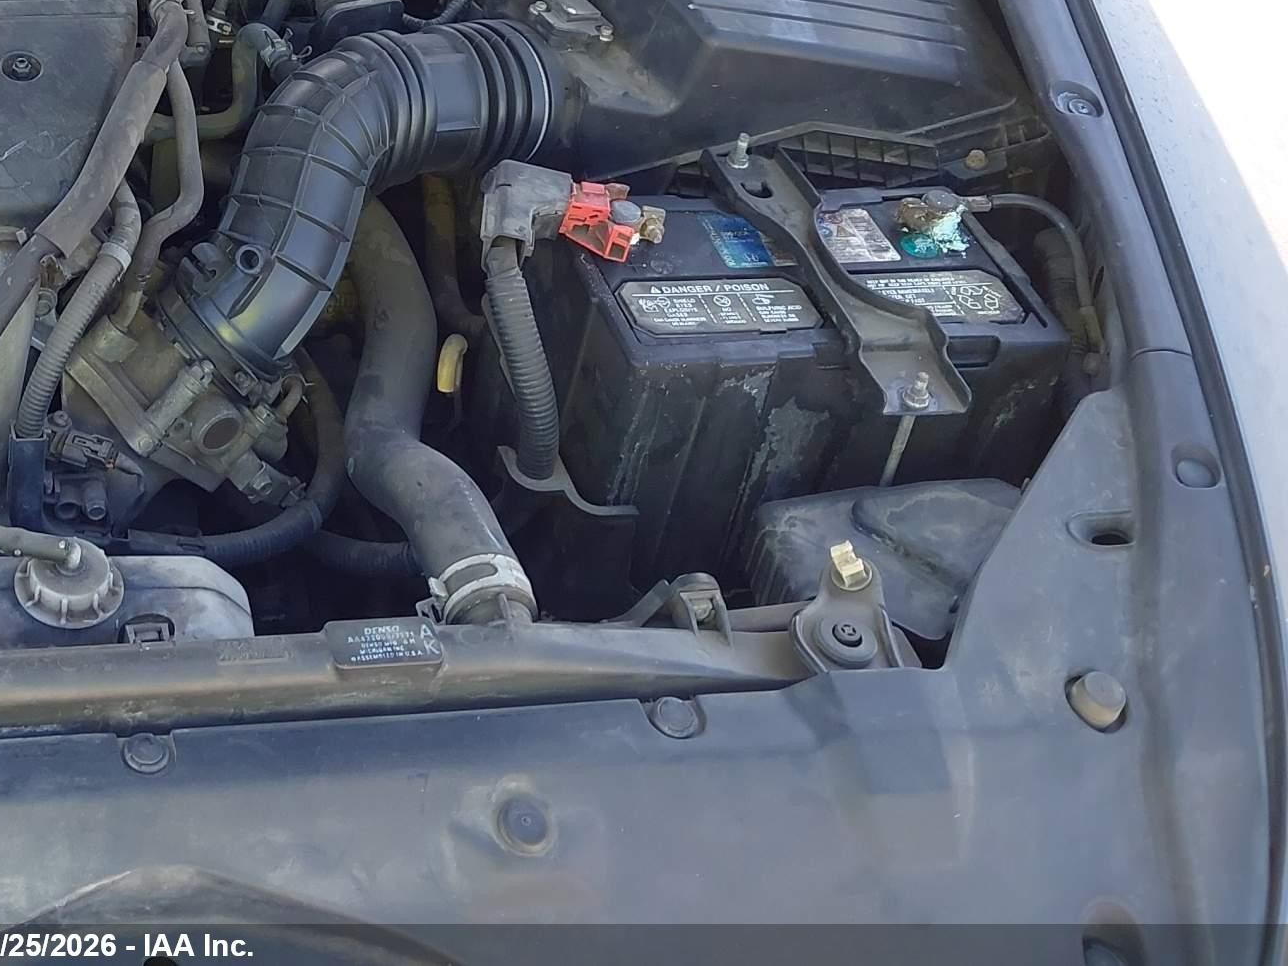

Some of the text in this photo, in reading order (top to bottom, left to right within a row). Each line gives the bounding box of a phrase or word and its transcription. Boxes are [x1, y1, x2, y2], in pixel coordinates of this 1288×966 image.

[661, 285, 713, 294] DANGER
[723, 283, 770, 292] POISON
[364, 625, 400, 635] DENSO
[420, 624, 433, 639] A
[423, 639, 440, 654] K
